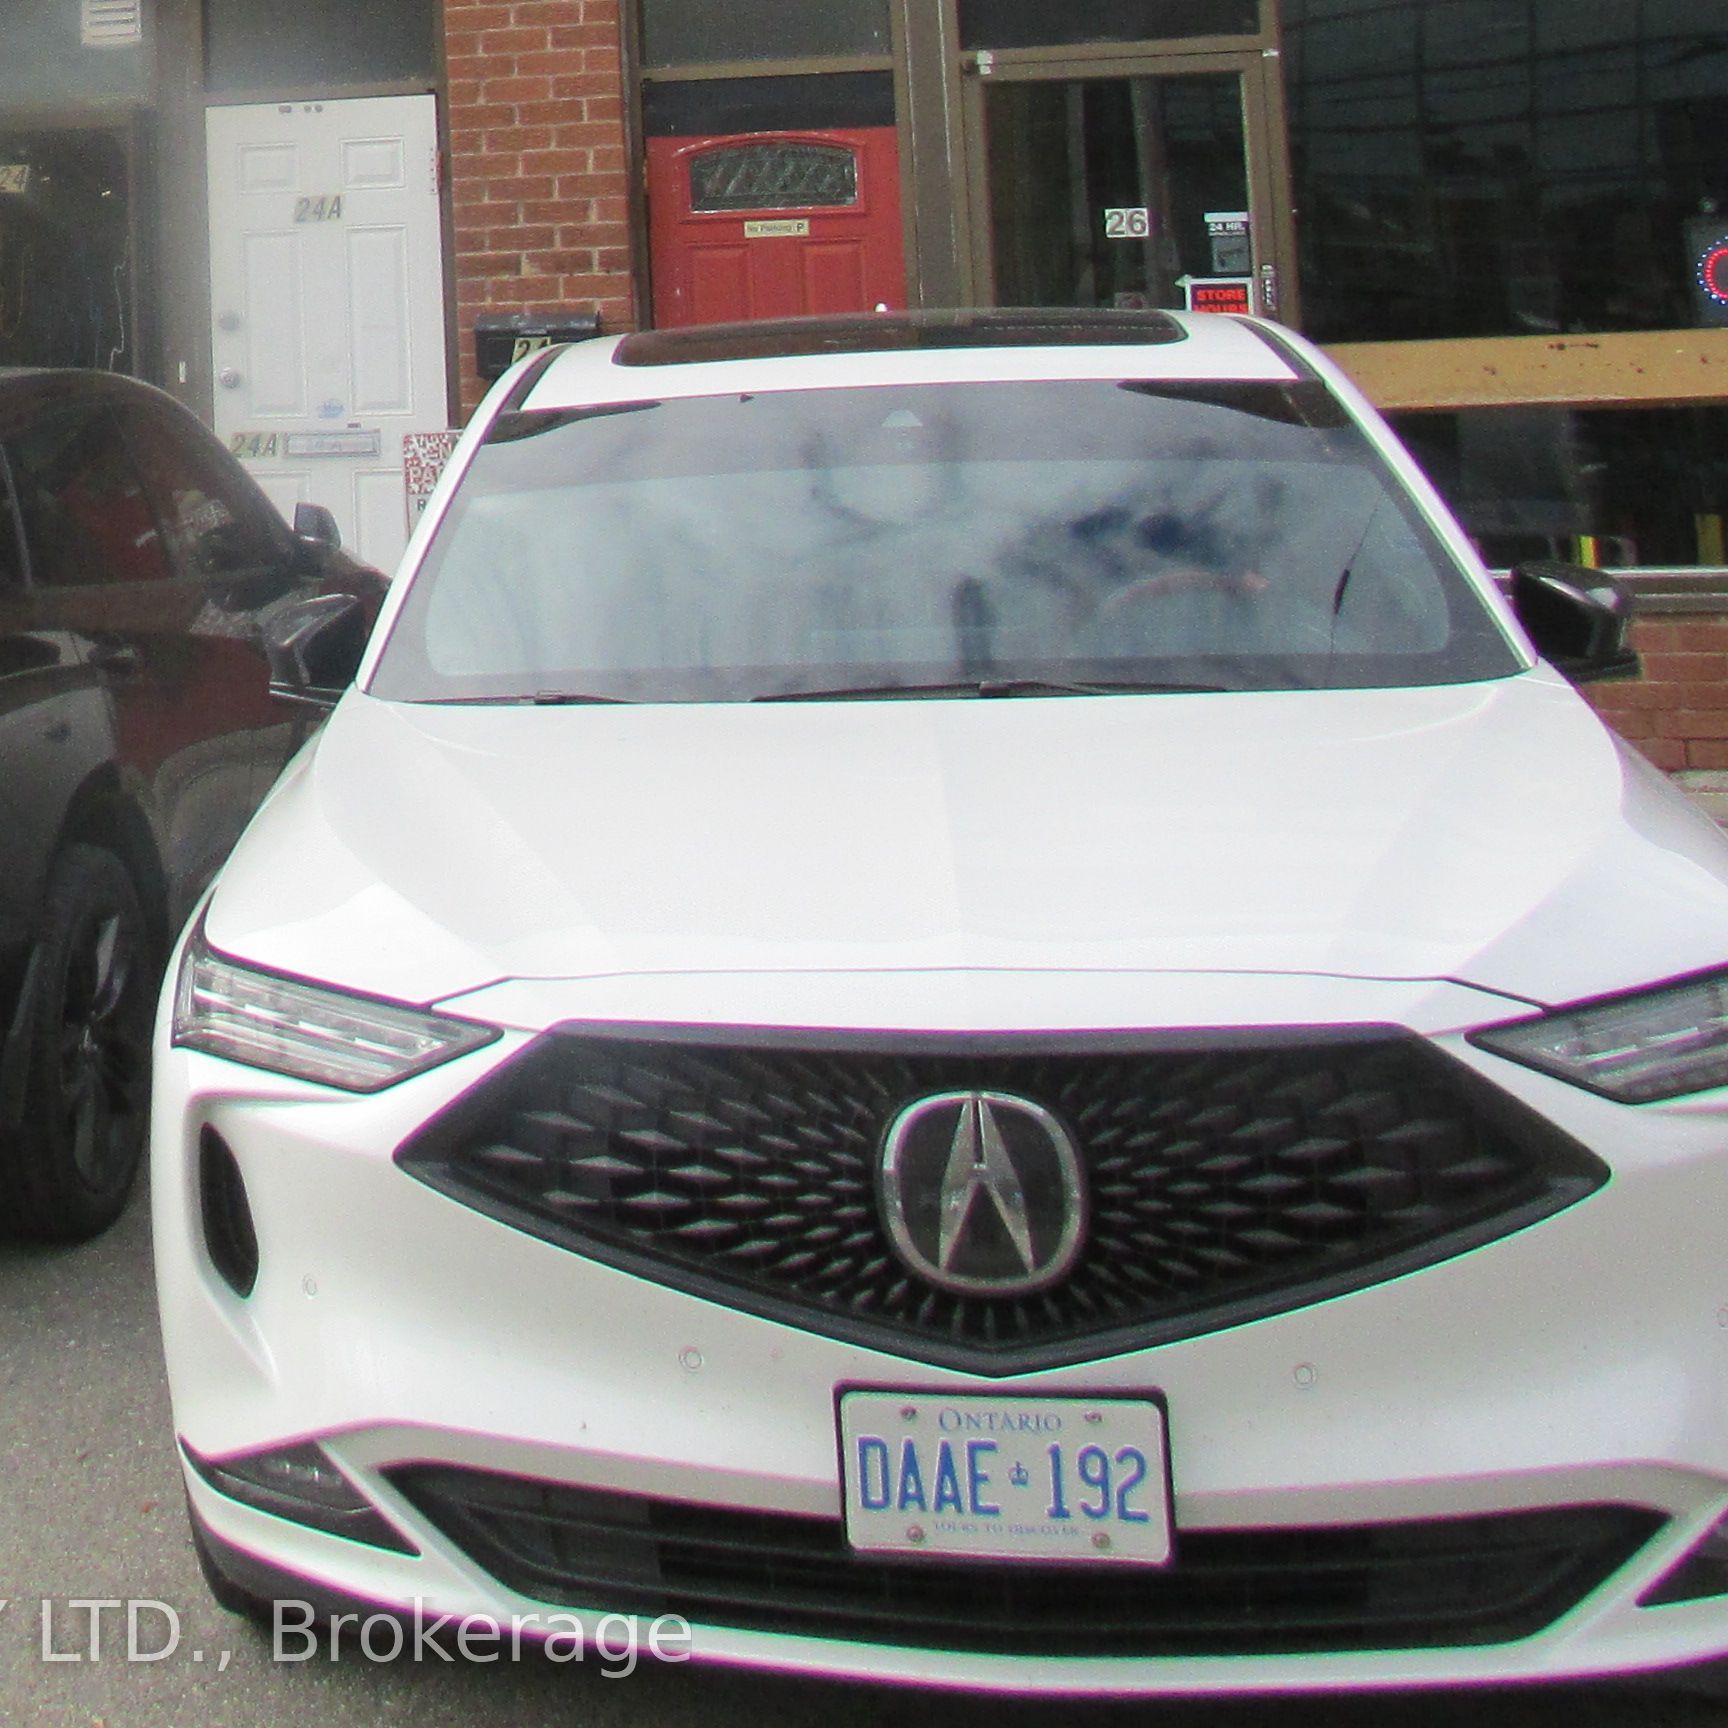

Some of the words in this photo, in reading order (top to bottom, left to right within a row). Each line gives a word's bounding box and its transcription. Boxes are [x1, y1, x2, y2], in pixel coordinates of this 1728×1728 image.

[295, 194, 343, 222] 24A
[1107, 210, 1147, 235] 26
[1196, 288, 1246, 301] STORE
[231, 432, 277, 457] 24A
[938, 1407, 1063, 1433] ONTARIO
[856, 1434, 1002, 1516] DAAE
[1046, 1443, 1152, 1523] 192
